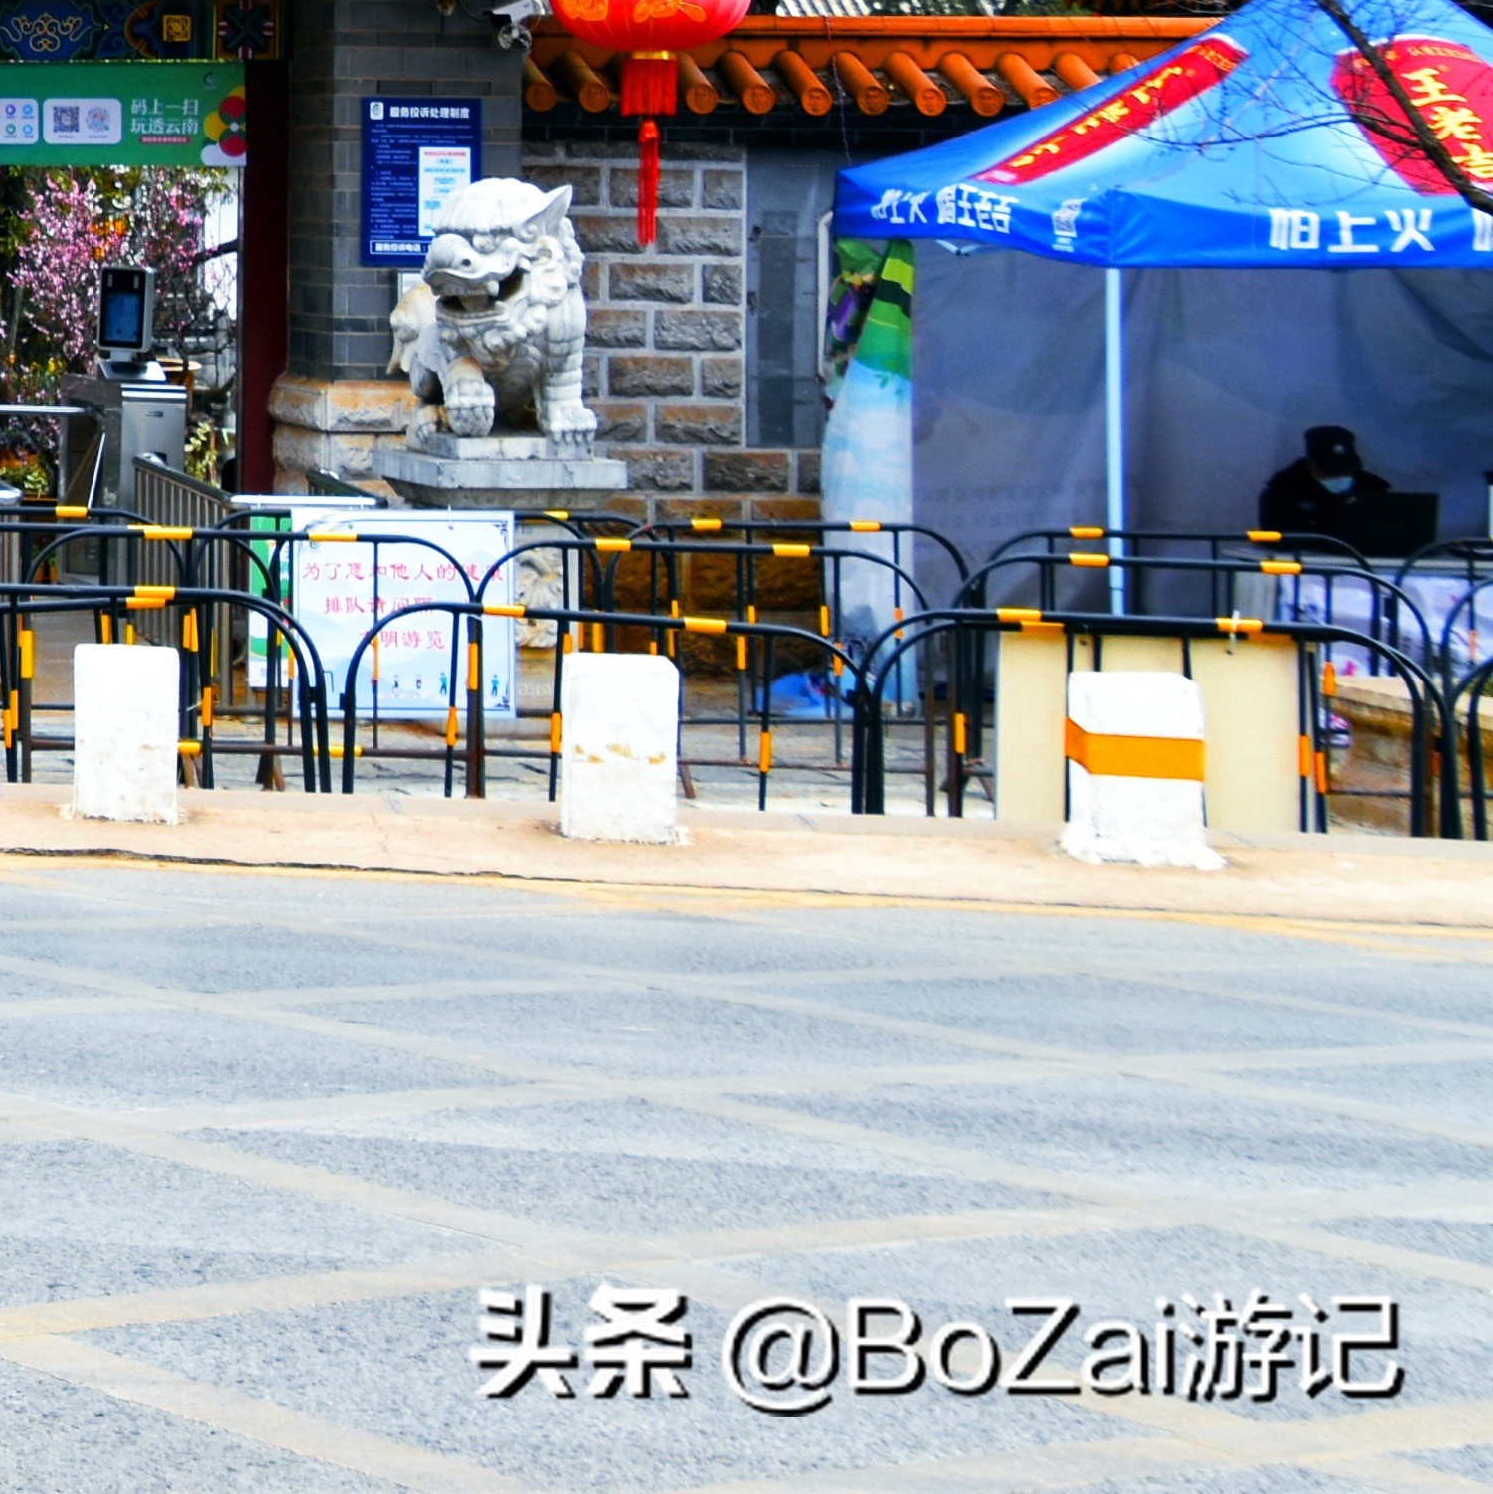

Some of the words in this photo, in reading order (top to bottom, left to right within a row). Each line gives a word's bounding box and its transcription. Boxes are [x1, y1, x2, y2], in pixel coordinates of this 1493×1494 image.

[130, 97, 199, 116] 码上一扫
[389, 106, 470, 119] 服务投诉处理制度
[130, 117, 199, 136] 玩透云南
